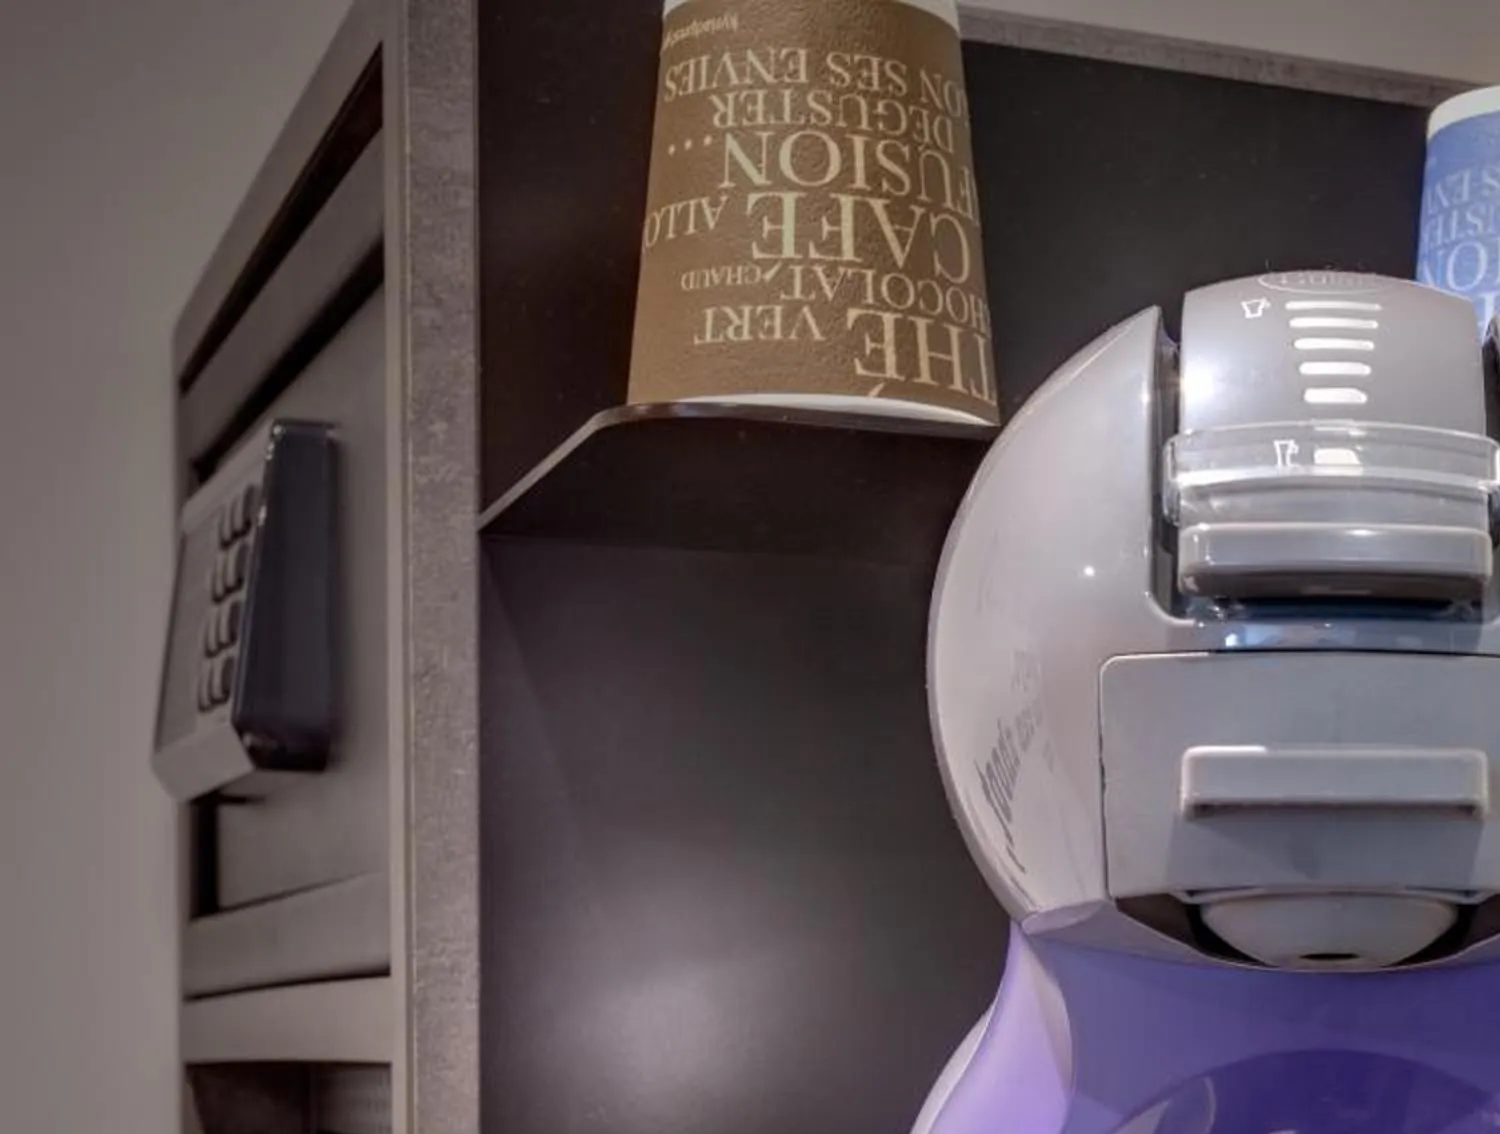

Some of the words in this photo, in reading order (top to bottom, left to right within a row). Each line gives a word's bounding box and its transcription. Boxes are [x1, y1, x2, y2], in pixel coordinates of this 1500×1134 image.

[665, 47, 808, 101] ENVIES
[826, 51, 907, 97] SES
[711, 88, 952, 153] DÉGUSTER
[746, 190, 970, 285] CAFÉ
[681, 265, 763, 291] CHAUD
[694, 304, 825, 345] VERT
[847, 307, 998, 405] THÉ
